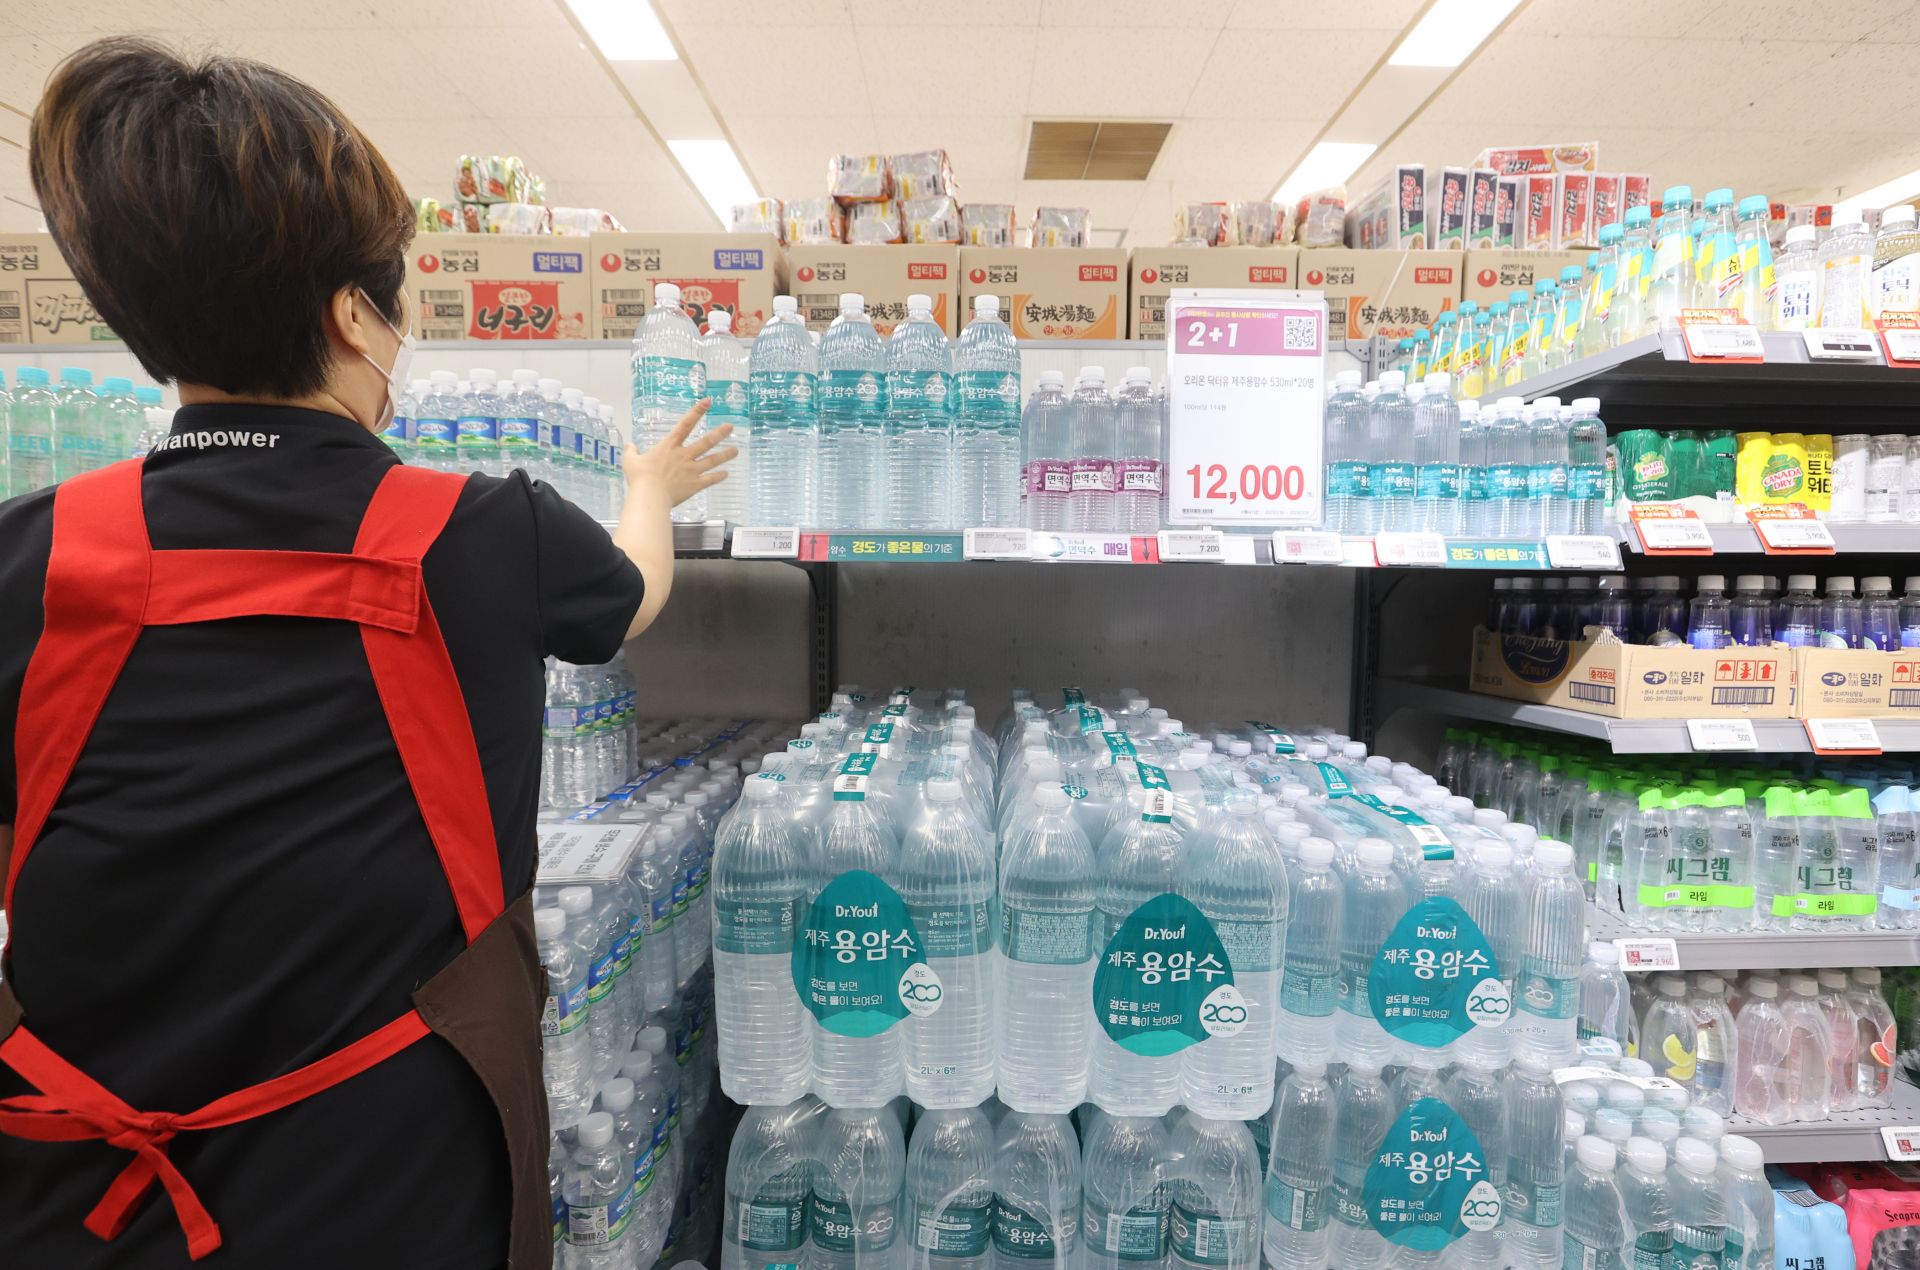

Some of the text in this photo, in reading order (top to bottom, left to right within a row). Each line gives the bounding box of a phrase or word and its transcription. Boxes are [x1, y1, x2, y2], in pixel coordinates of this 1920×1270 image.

[1, 254, 39, 271] 농심
[443, 258, 479, 272] 농심
[536, 255, 580, 271] 멀티팩
[624, 256, 660, 272] 농심
[717, 252, 760, 268] 멀티팩
[817, 269, 846, 281] 농심
[911, 265, 944, 278] 멀티팩
[988, 270, 1018, 283] 농심
[1082, 267, 1114, 279] 멀티팩
[1160, 271, 1188, 283] 농심
[1252, 269, 1284, 281] 멀티팩
[1418, 270, 1450, 282] 멀티팩
[1326, 272, 1354, 285] 농심
[1500, 272, 1534, 286] 농심
[477, 303, 555, 332] 너구리
[1187, 321, 1238, 348] 2+1
[1184, 376, 1206, 387] 오리온
[825, 386, 855, 398] 용암수
[154, 430, 280, 453] Manpower
[1074, 473, 1100, 484] 면역수
[1126, 473, 1153, 484] 면역수
[1764, 468, 1802, 487] CANADA
[1186, 464, 1305, 505] 12,000
[1774, 479, 1793, 491] DRY
[852, 541, 886, 554] 경도가
[1104, 542, 1129, 556] 매일
[1590, 670, 1615, 680] 충격주의
[1680, 670, 1704, 685] 일화
[1860, 672, 1883, 687] 일화
[1666, 857, 1730, 882] 씨그램
[1690, 891, 1708, 902] 라임
[1818, 900, 1834, 911] 라임
[804, 928, 917, 964] 제주 용암수
[1107, 950, 1226, 984] 제주 용암수
[1384, 948, 1490, 980] 제주 용암수
[914, 970, 926, 978] 경도
[810, 978, 858, 992] 경도를 보면
[902, 980, 942, 1002] 200
[1484, 984, 1497, 992] 경도
[852, 995, 883, 1006] 보여요!
[1220, 991, 1232, 1000] 경도
[1386, 994, 1430, 1006] 경도를 보면
[1110, 998, 1160, 1013] 경도를 보면
[1469, 995, 1510, 1014] 200
[1203, 1003, 1247, 1024] 200
[1422, 1008, 1450, 1019] 보여요!
[1152, 1014, 1182, 1027] 보여요!
[920, 1066, 932, 1075] 2L
[1217, 1084, 1230, 1094] 2L
[1378, 1151, 1482, 1184] 제주 용암수
[1477, 1187, 1489, 1196] 경도
[1380, 1199, 1425, 1210] 경도를 보면
[1463, 1200, 1500, 1218] 200
[1418, 1212, 1442, 1222] 보여요!
[1008, 1227, 1050, 1246] 용암수
